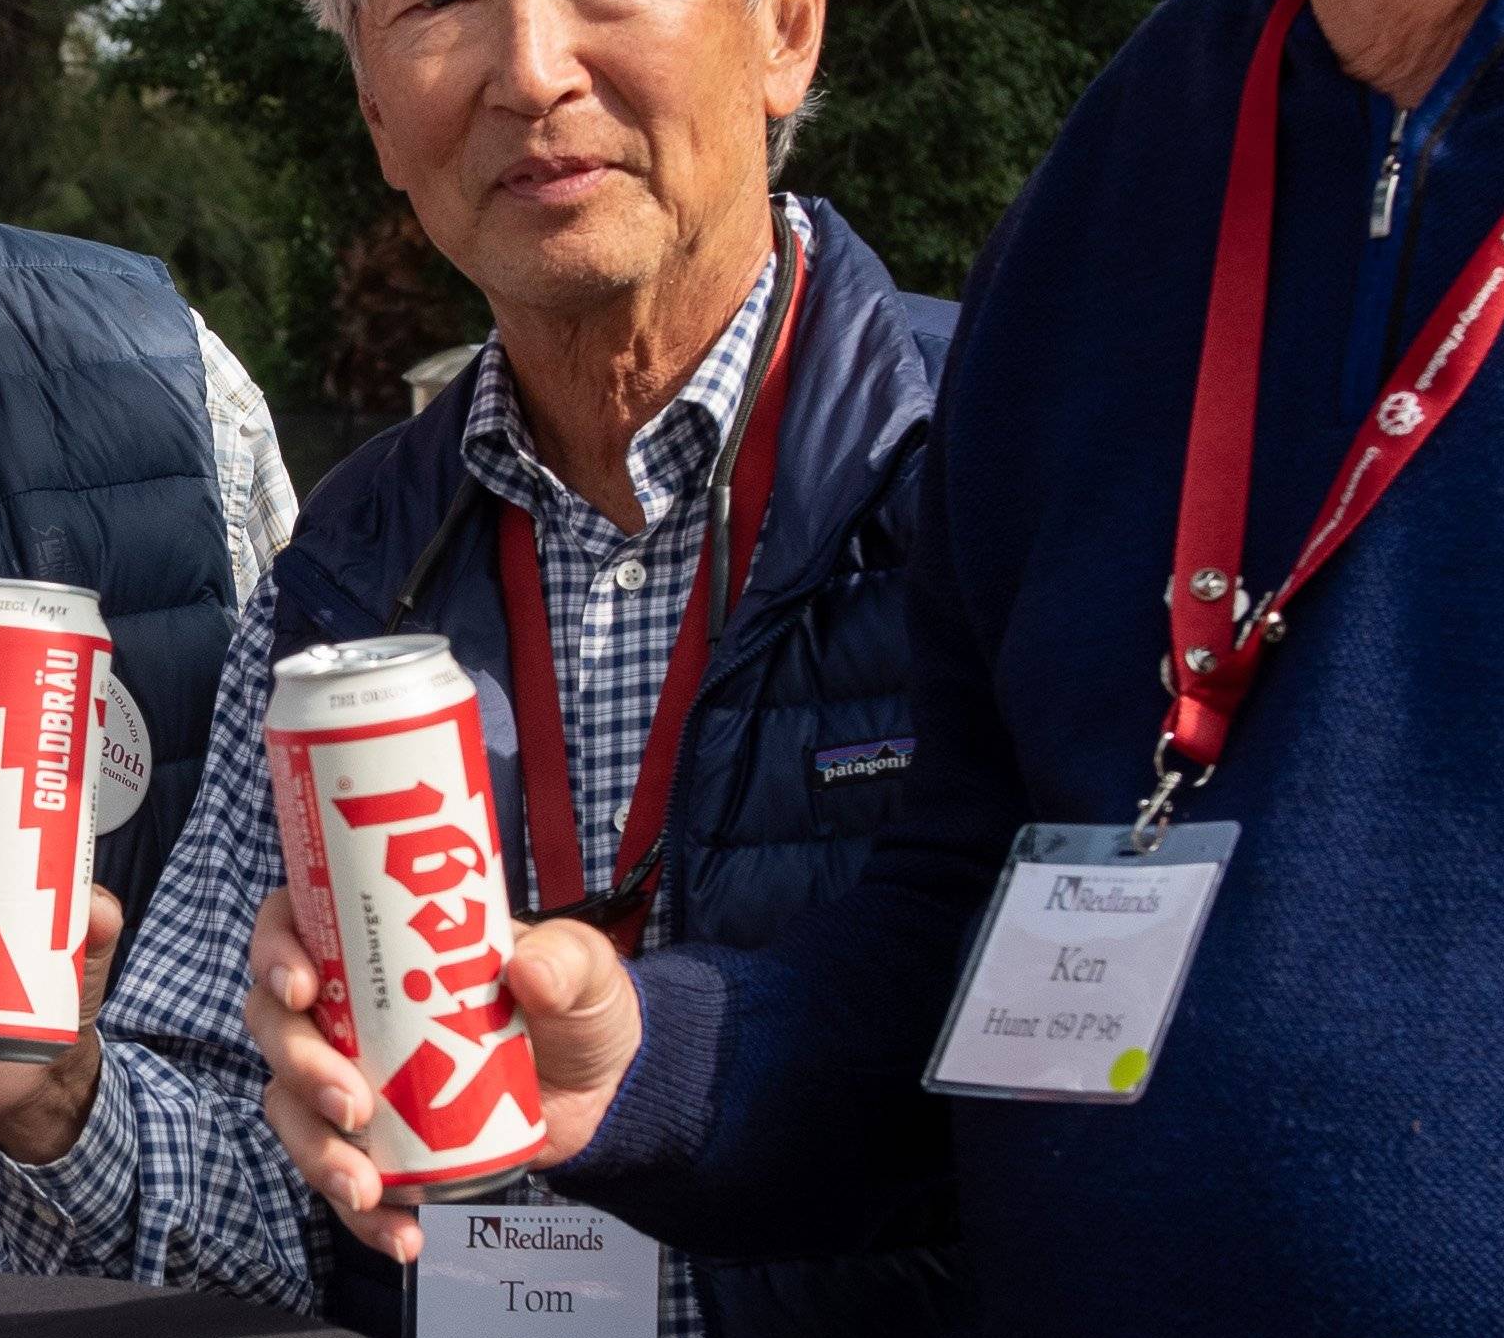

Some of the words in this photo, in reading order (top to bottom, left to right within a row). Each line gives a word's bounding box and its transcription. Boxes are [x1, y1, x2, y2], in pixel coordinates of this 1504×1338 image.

[33, 647, 80, 812] GOLDBRÄU
[333, 780, 544, 1153] Stiegl
[360, 891, 391, 1011] Salzburger
[1049, 945, 1109, 984] Ken
[981, 1007, 1041, 1039] Hunt
[503, 1216, 581, 1224] UNIVERSITY
[589, 1216, 605, 1224] OF
[503, 1226, 605, 1251] Redlands
[499, 1279, 576, 1313] Tom
